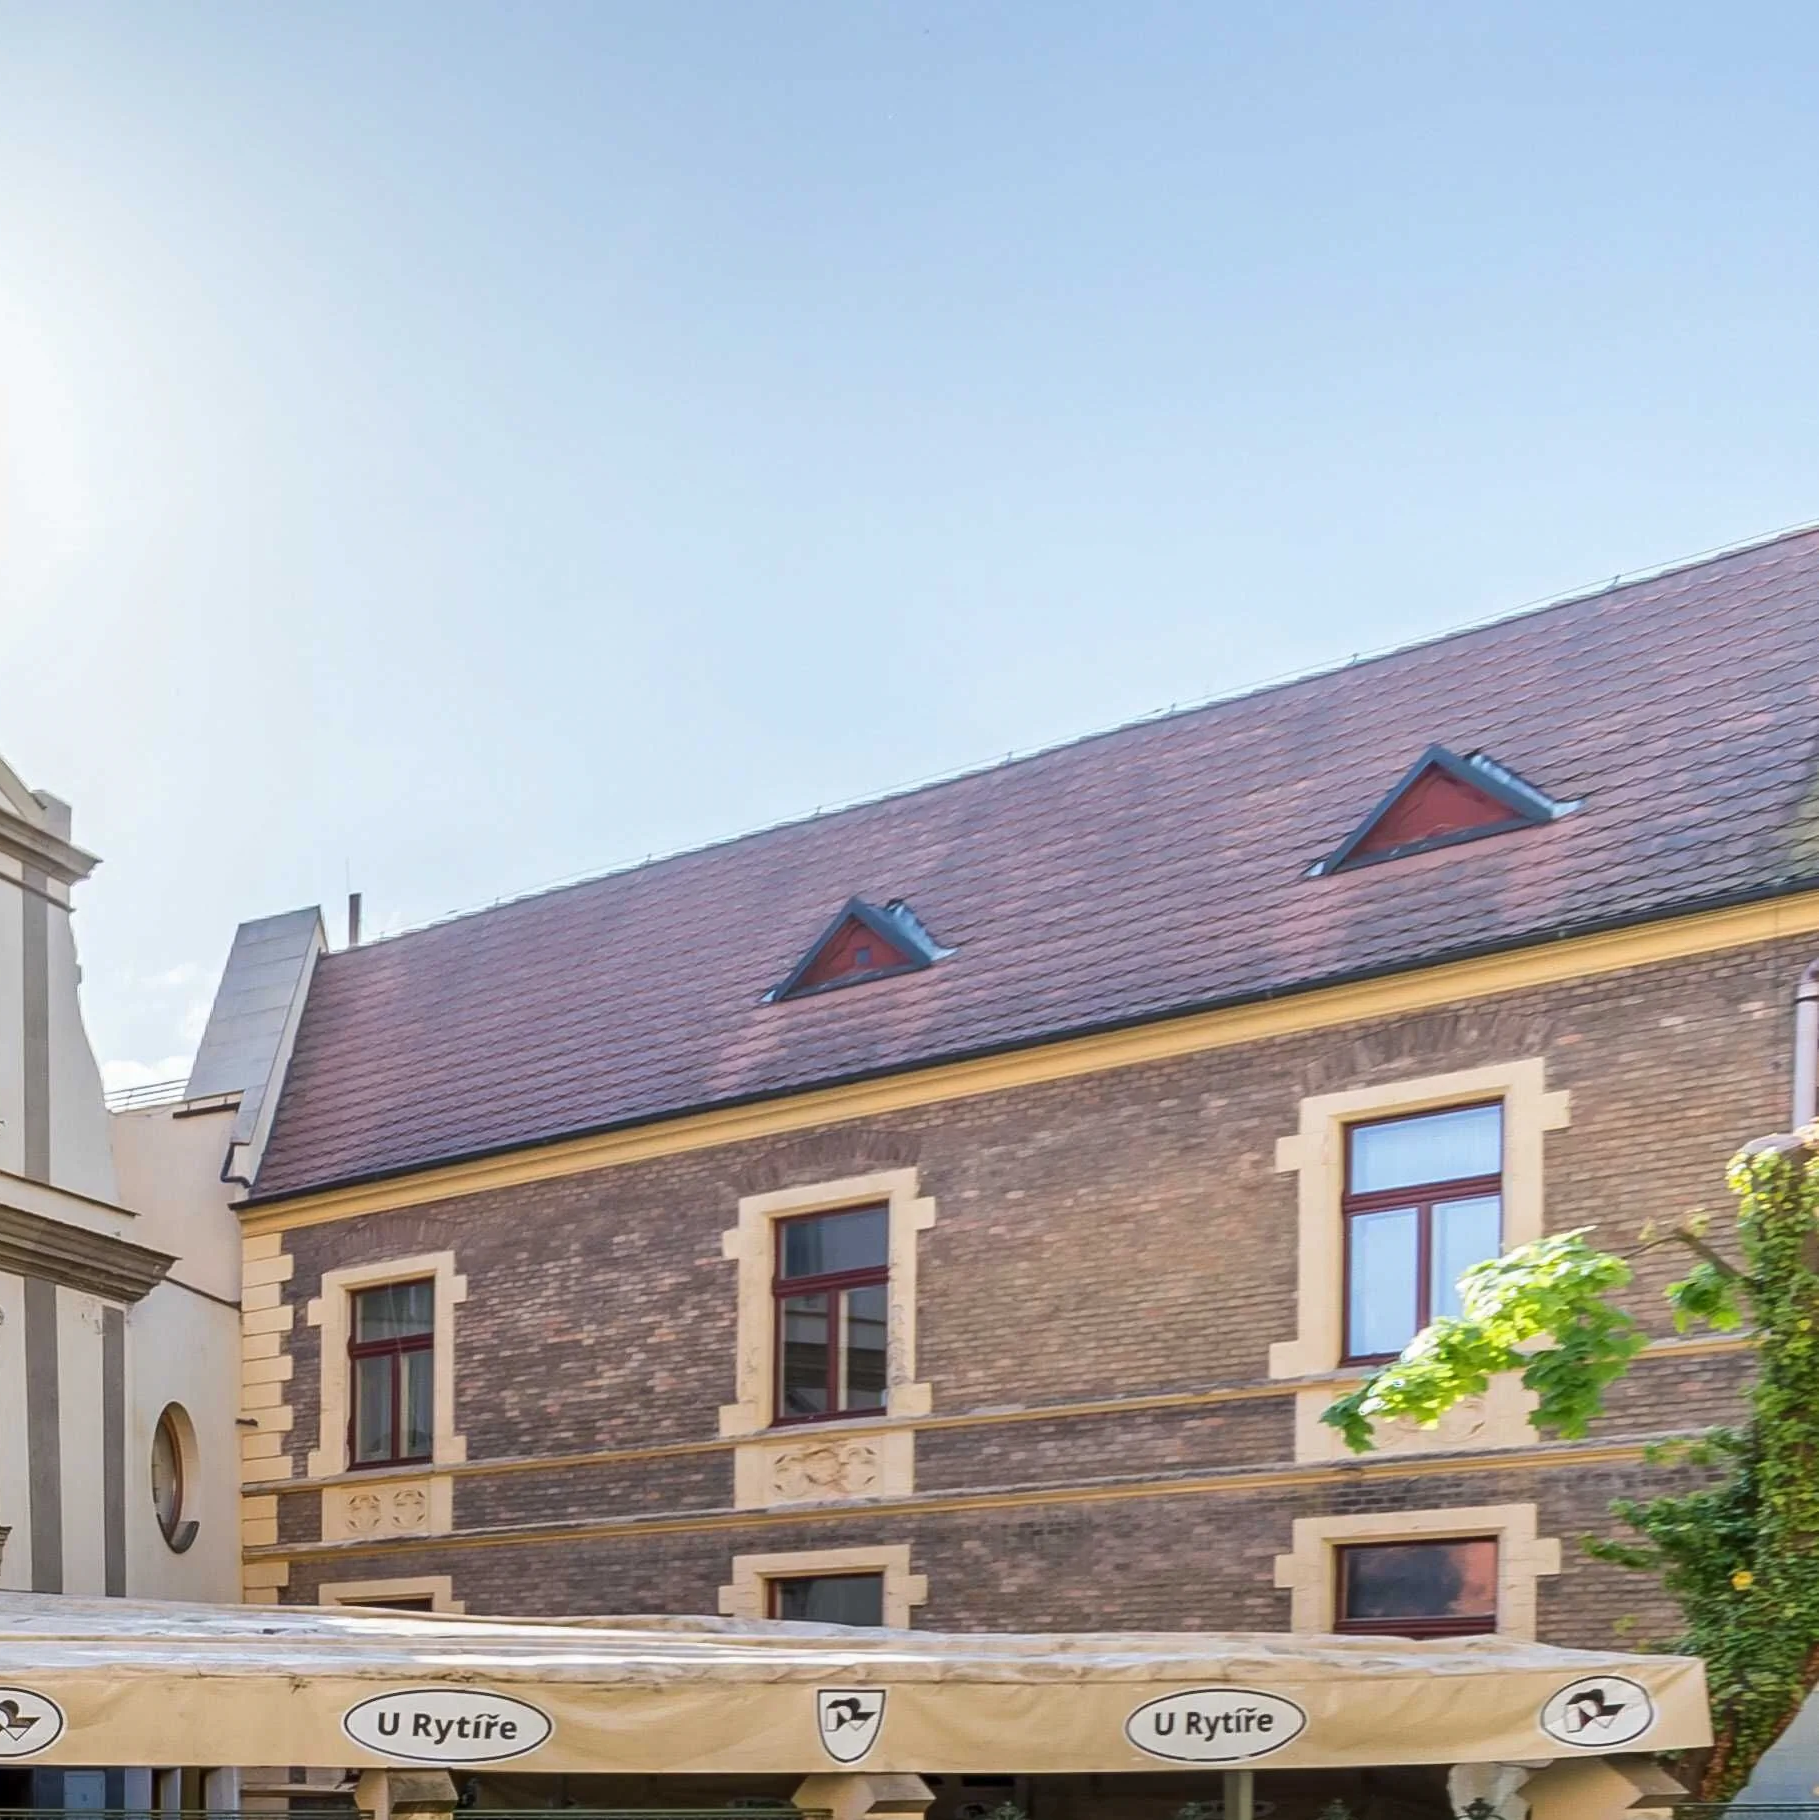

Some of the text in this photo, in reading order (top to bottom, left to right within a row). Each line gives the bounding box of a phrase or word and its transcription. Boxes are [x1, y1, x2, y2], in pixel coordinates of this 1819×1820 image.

[378, 1712, 518, 1745] U Rytíře
[1155, 1707, 1274, 1742] U Rytíře
